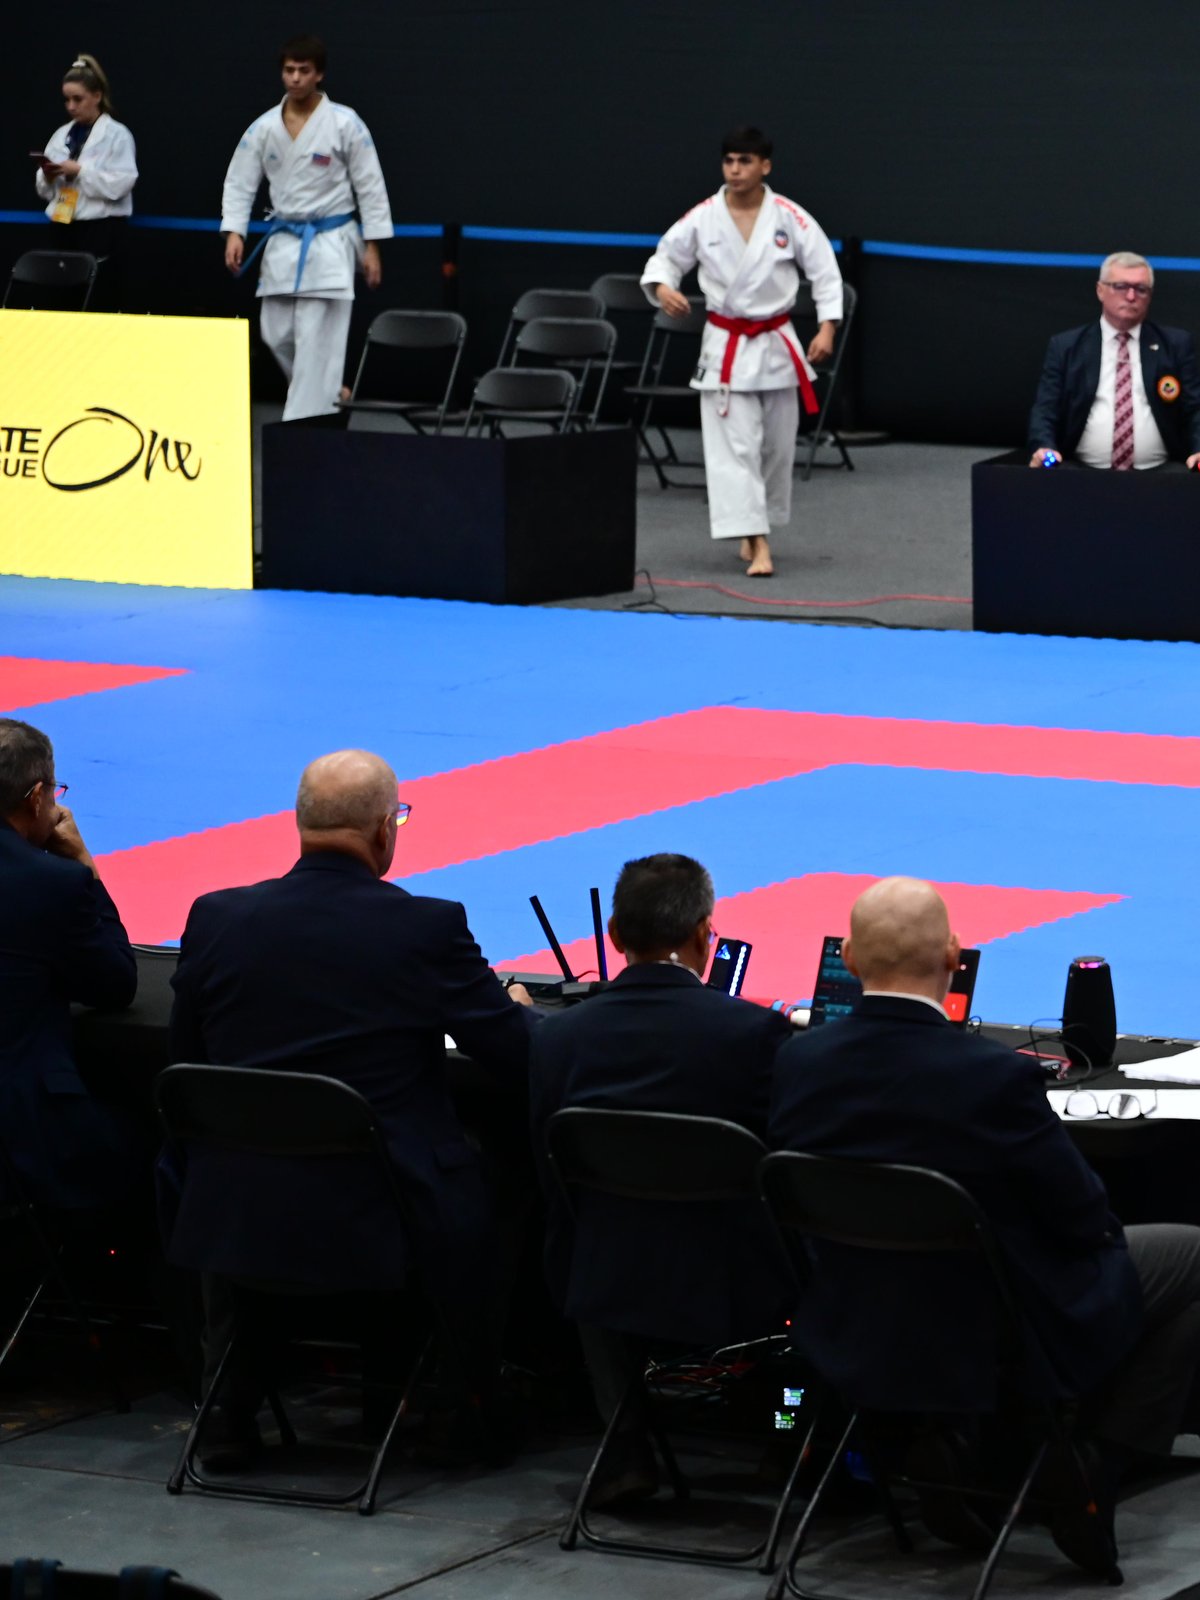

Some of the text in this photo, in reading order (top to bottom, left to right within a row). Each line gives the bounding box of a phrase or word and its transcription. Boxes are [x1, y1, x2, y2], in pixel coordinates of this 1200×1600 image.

[0, 427, 42, 454] TE
[42, 407, 201, 491] One
[0, 458, 38, 478] UE
